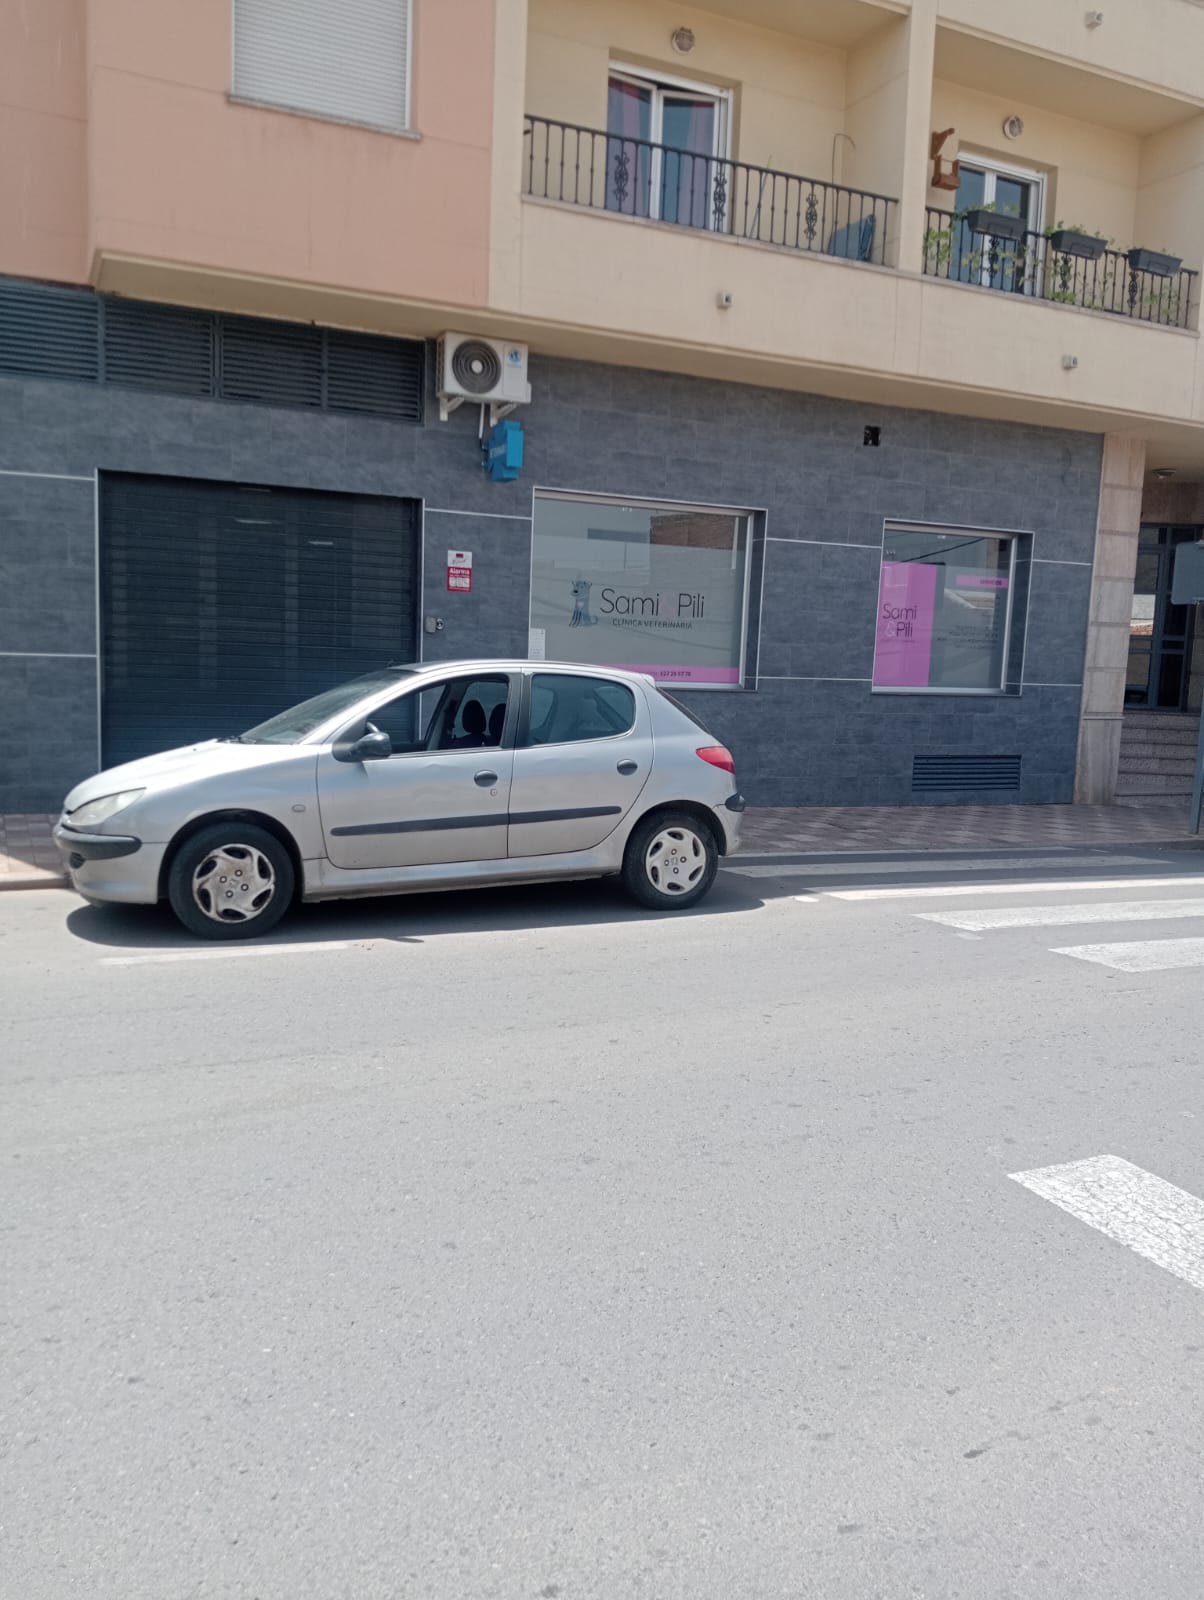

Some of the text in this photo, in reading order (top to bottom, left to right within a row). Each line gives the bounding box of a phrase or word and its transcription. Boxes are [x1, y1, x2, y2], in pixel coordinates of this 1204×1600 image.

[600, 588, 660, 616] Sami
[678, 593, 705, 618] Pili
[882, 603, 918, 621] Sami
[643, 620, 693, 630] VETERINARIA
[896, 621, 913, 638] Pili
